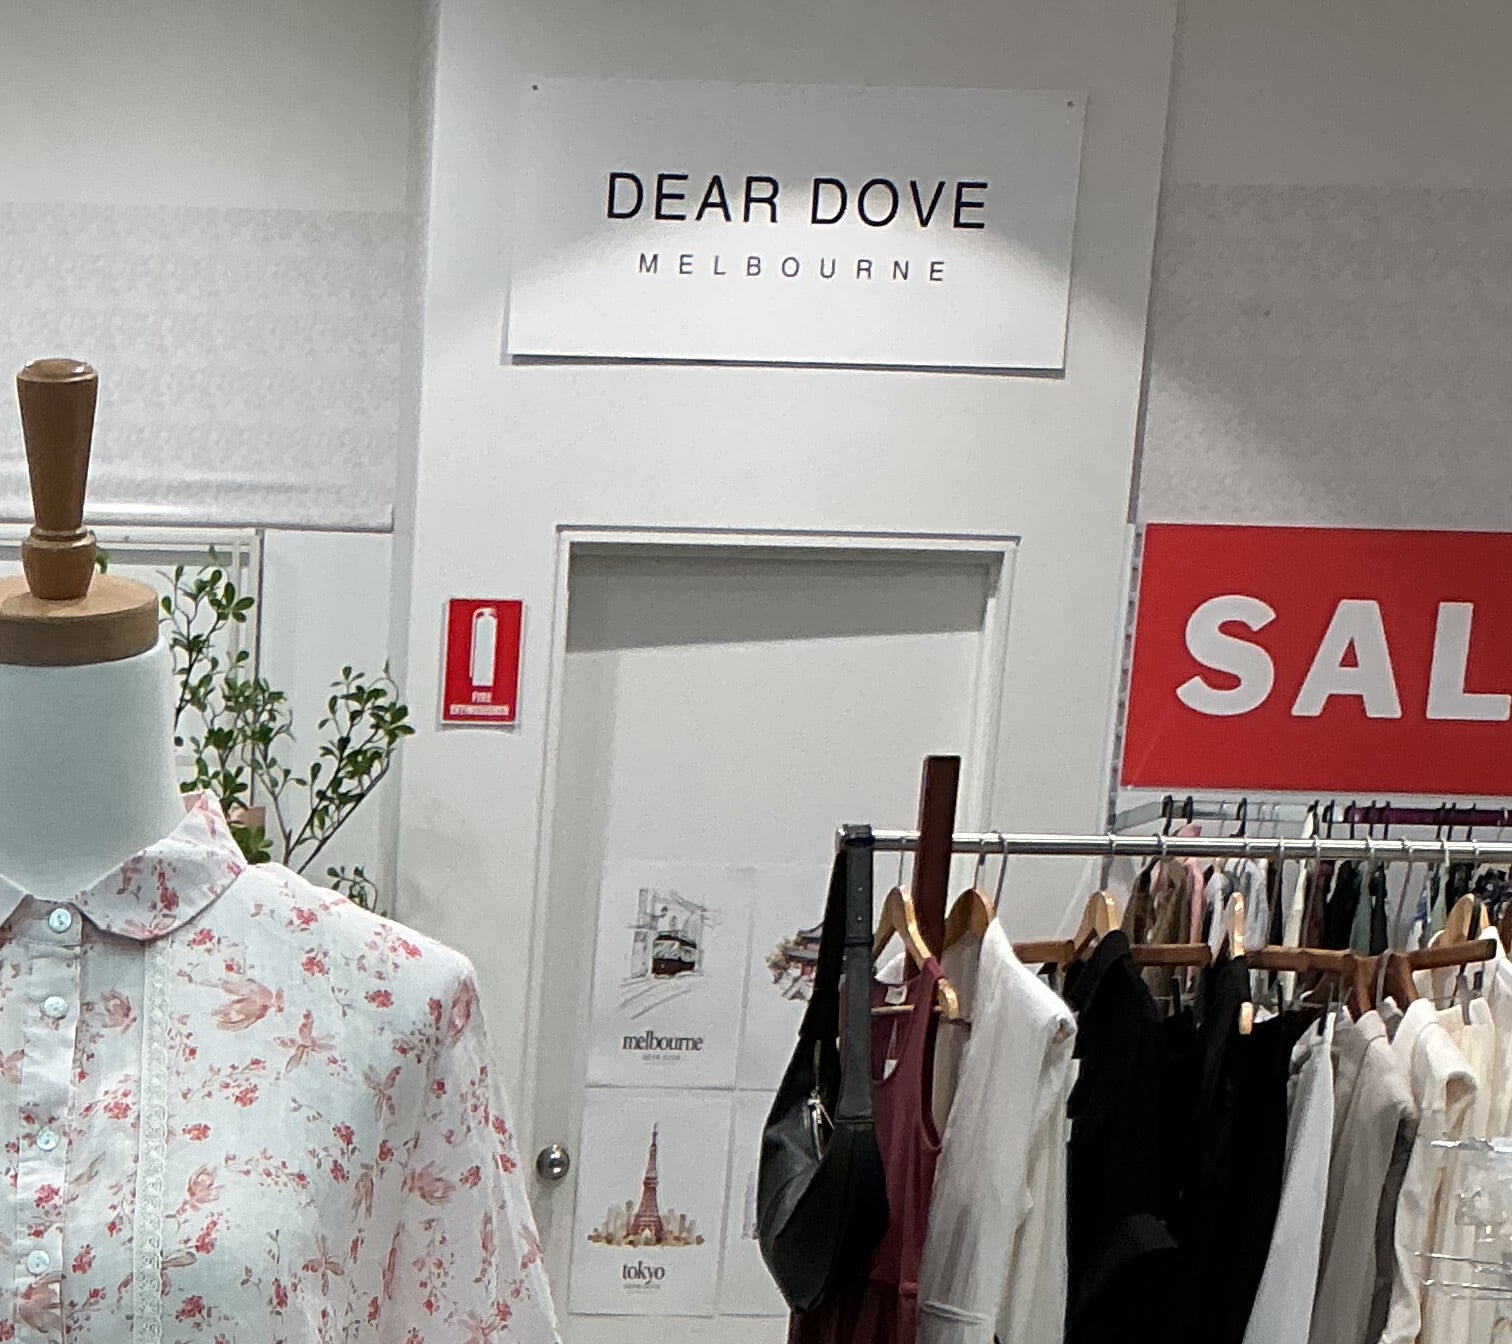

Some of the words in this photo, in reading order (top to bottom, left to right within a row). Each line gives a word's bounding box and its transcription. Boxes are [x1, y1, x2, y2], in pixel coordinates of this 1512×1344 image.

[606, 171, 779, 224] DEAR
[810, 177, 989, 230] DOVE
[638, 252, 946, 282] MELBOURNE
[1175, 594, 1512, 721] SAL
[622, 1030, 704, 1051] melbourne
[622, 1261, 665, 1285] tokyo
